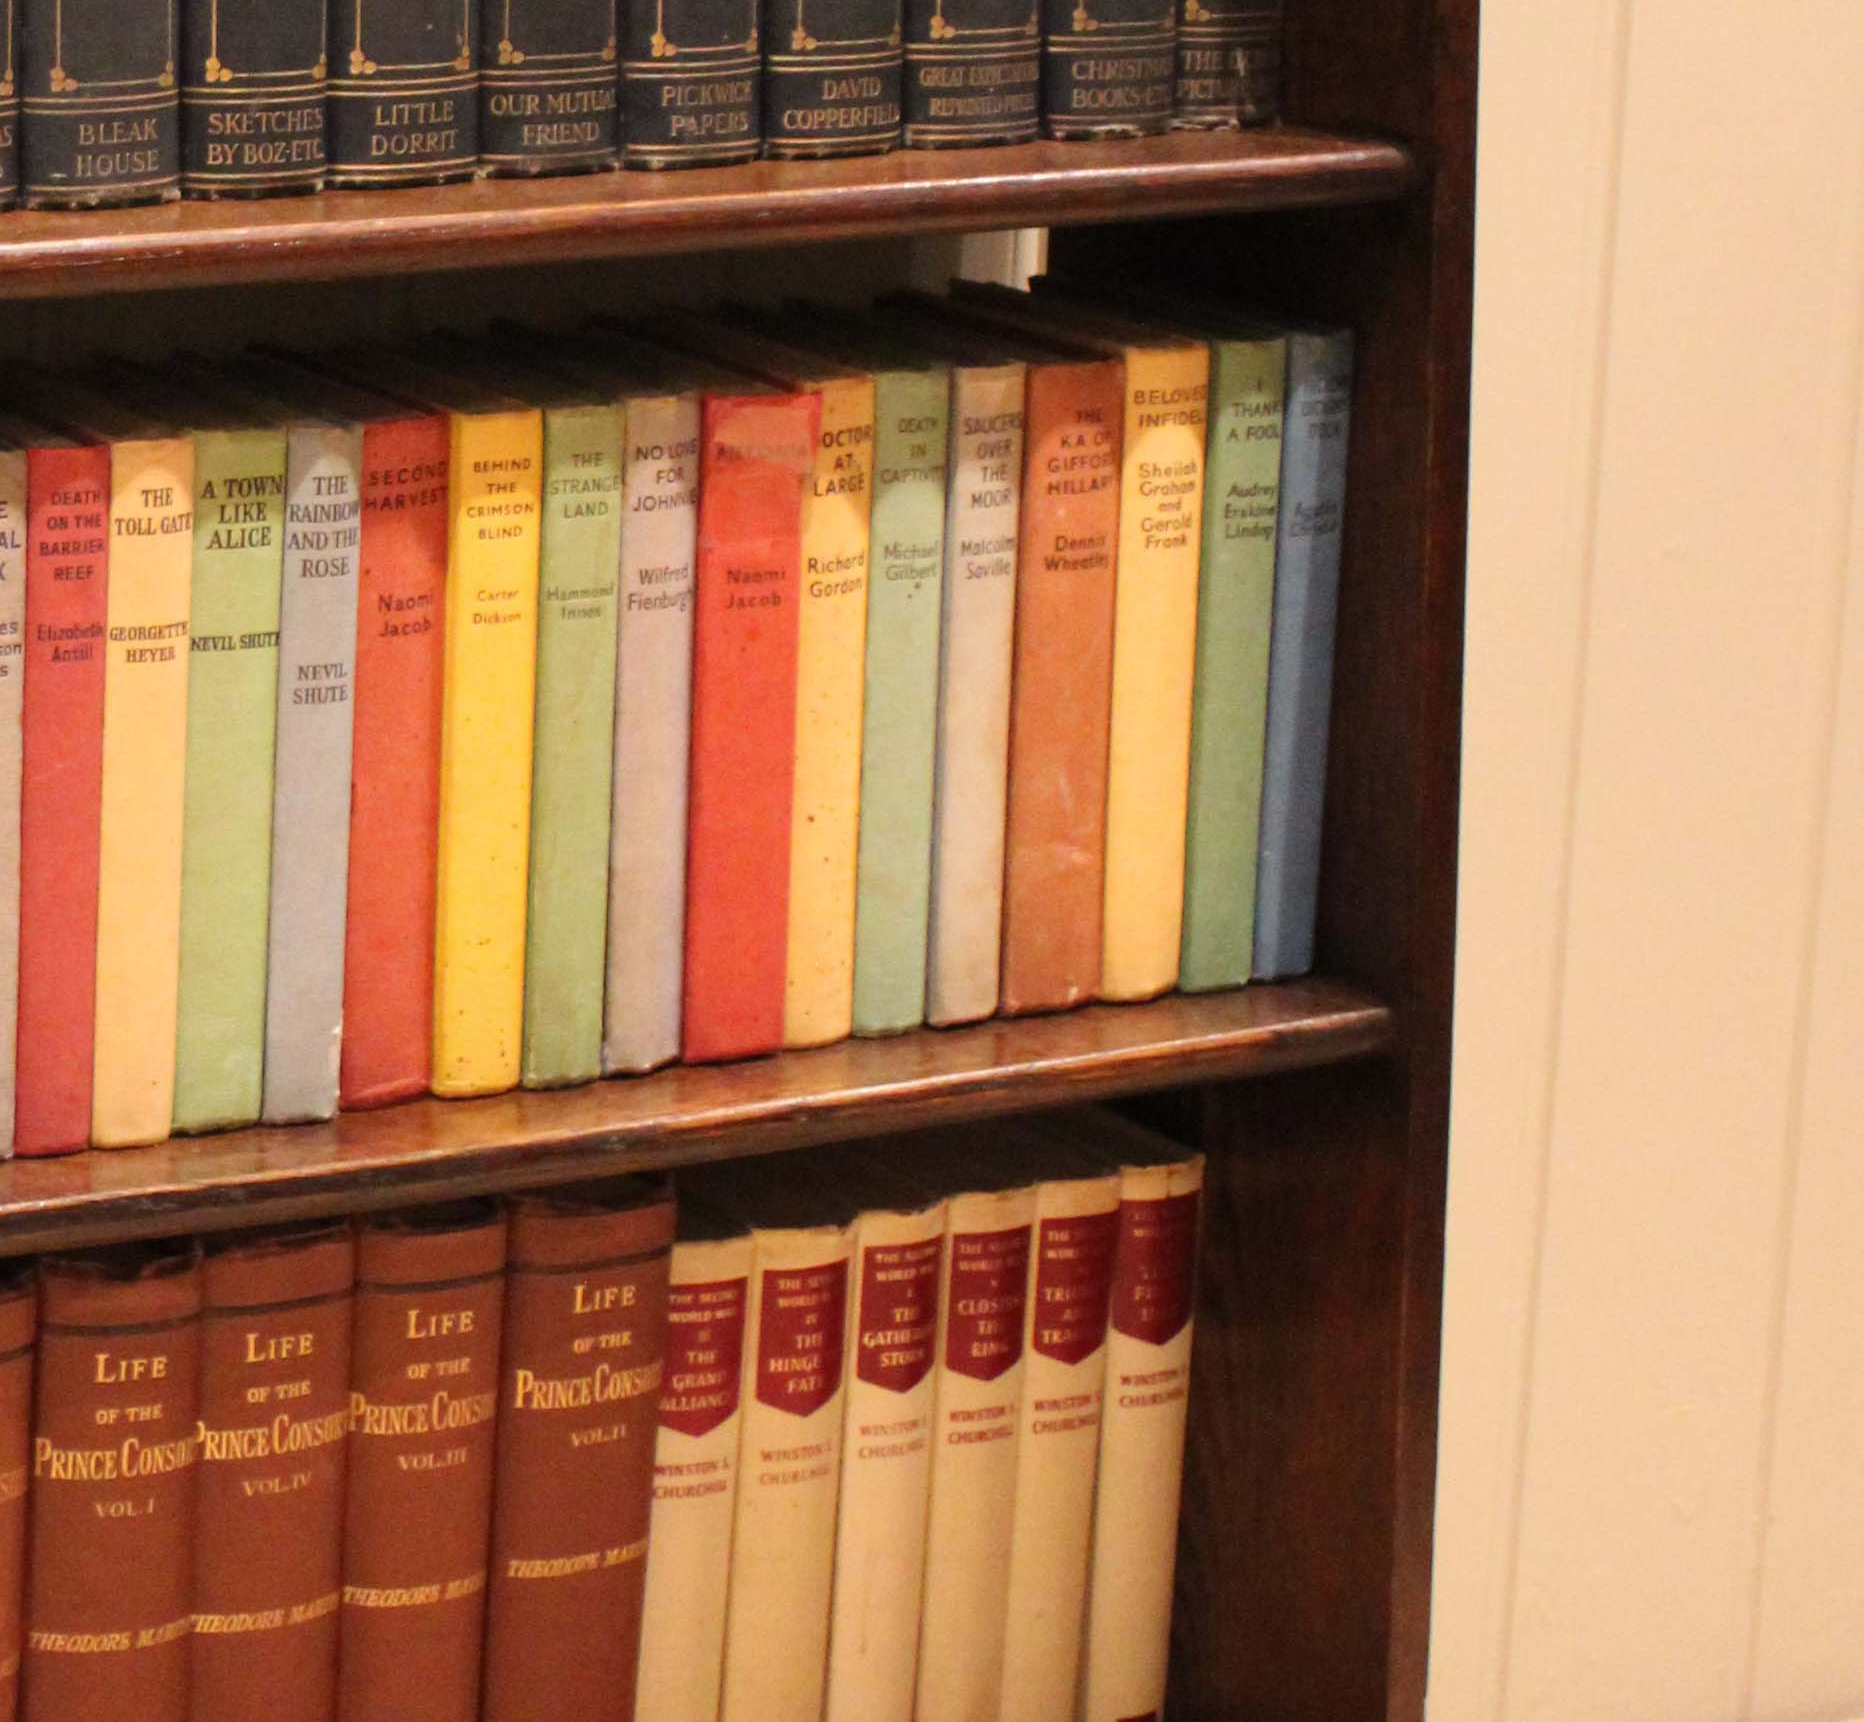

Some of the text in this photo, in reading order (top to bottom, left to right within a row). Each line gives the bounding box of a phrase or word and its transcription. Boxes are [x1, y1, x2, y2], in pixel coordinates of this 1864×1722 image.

[821, 76, 882, 101] DAVID
[375, 99, 455, 127] LITTLE
[489, 87, 616, 118] OUR MUTUAL
[207, 107, 325, 135] SKETCHES
[783, 102, 901, 130] COPPERFIELD
[77, 117, 159, 147] BLEAK
[371, 128, 457, 156] DORRIT
[521, 120, 600, 146] FRIEND
[74, 150, 161, 178] HOUSE
[472, 457, 533, 474] BEHIND
[569, 452, 605, 469] THE
[200, 473, 285, 501] A TOWN
[312, 475, 349, 496] THE
[485, 480, 519, 495] THE
[812, 471, 866, 497] LARGE
[50, 488, 103, 506] DEATH
[141, 487, 173, 508] THE
[46, 514, 103, 530] ON THE
[217, 501, 268, 524] LIKE
[288, 501, 360, 524] RAINBOW
[466, 501, 536, 520] CRIMSON
[562, 501, 609, 520] LAND
[114, 511, 193, 536] TOLL GATE
[477, 525, 524, 541] BLIND
[205, 526, 272, 550] ALICE
[287, 527, 359, 551] AND THE
[53, 566, 96, 582] REEF
[300, 556, 351, 578] ROSE
[476, 587, 521, 603] Carter
[124, 647, 177, 664] HEYER
[296, 662, 348, 682] NEVIL
[292, 683, 349, 706] SHUTE
[573, 1283, 637, 1316] LIFE
[405, 1308, 476, 1340] LIFE
[245, 1332, 315, 1364] LIFE
[94, 1350, 169, 1384] LIFE
[246, 1379, 312, 1404] OF THE
